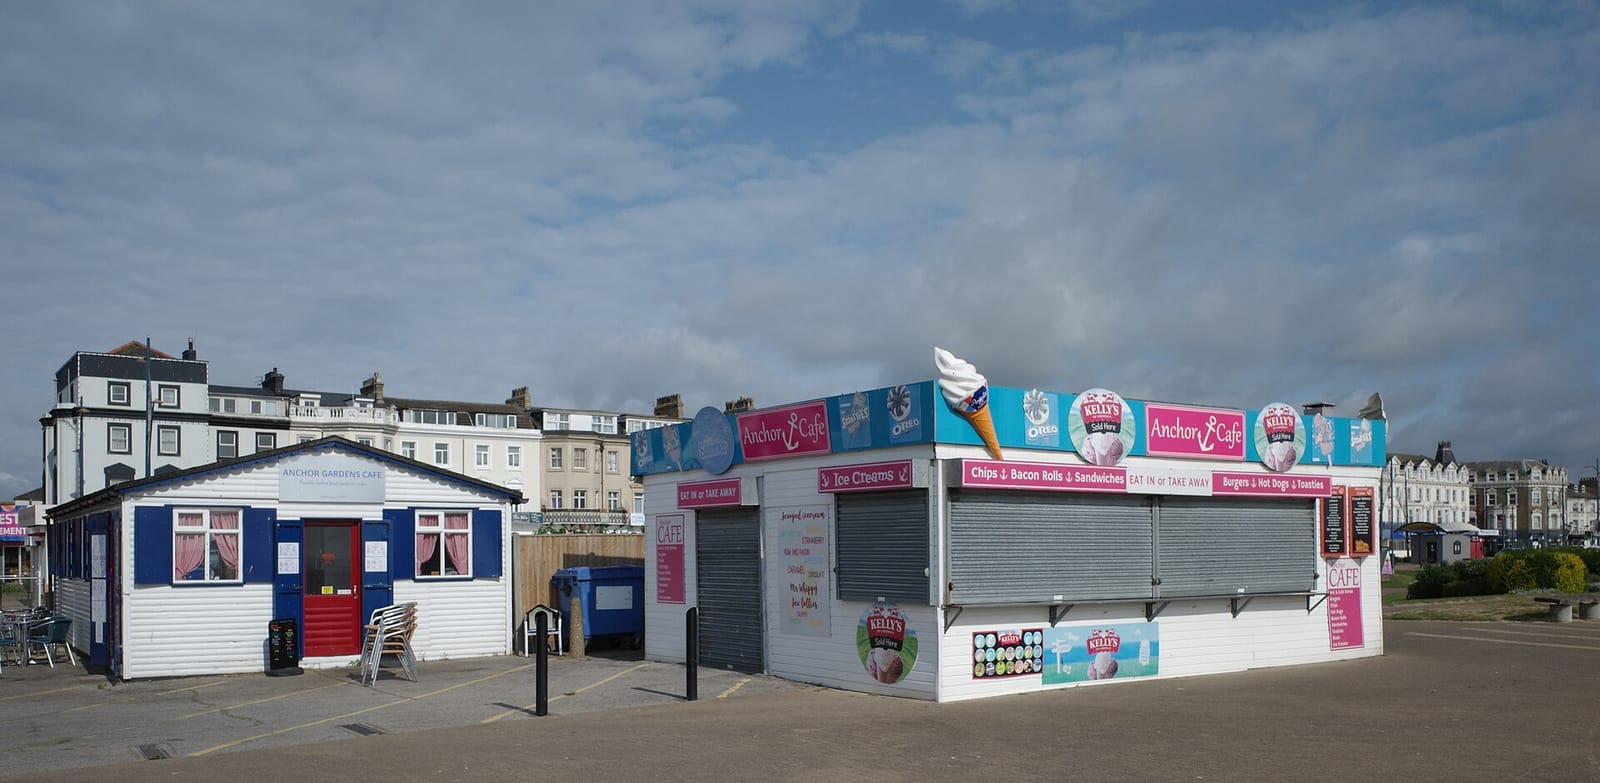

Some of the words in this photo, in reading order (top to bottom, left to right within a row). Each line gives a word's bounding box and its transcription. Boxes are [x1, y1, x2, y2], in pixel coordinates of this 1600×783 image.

[1084, 404, 1119, 416] KELLY'S
[892, 418, 920, 436] OREO
[1091, 423, 1103, 431] Sold
[1104, 423, 1116, 431] Here
[1266, 416, 1294, 428] KELLY'S
[744, 421, 783, 445] Anchor
[799, 413, 825, 443] Cafe
[1028, 426, 1057, 439] OREO
[1151, 417, 1198, 440] Anchor
[1216, 422, 1242, 449] Cafe
[1272, 433, 1283, 442] Sold
[283, 469, 319, 478] ANCHOR
[322, 470, 360, 478] GARDENS
[362, 471, 382, 479] CAFE
[834, 473, 850, 486] Ice
[852, 470, 894, 484] Creams
[971, 467, 998, 481] Chips
[1011, 470, 1040, 481] Bacon
[1042, 470, 1063, 482] Rolls
[1074, 472, 1125, 484] Sandwiches
[1130, 475, 1143, 485] EAT
[1146, 475, 1155, 485] IN
[1158, 477, 1165, 486] or
[1168, 476, 1186, 487] TAKE
[1188, 478, 1210, 488] AWAY
[1223, 477, 1250, 491] Burgers
[1258, 478, 1270, 488] Hot
[1272, 478, 1290, 492] Dogs
[1297, 479, 1324, 490] Toasties
[680, 492, 689, 500] EAT
[691, 490, 697, 499] IN
[706, 489, 719, 498] TAKE
[720, 488, 736, 497] AWAY
[0, 514, 18, 524] EST
[658, 525, 682, 543] CAFE
[1329, 568, 1359, 587] CAFE
[870, 618, 902, 632] KELLY'S
[874, 638, 885, 646] Sold
[886, 638, 898, 648] Here
[1089, 638, 1118, 648] KELLY'S
